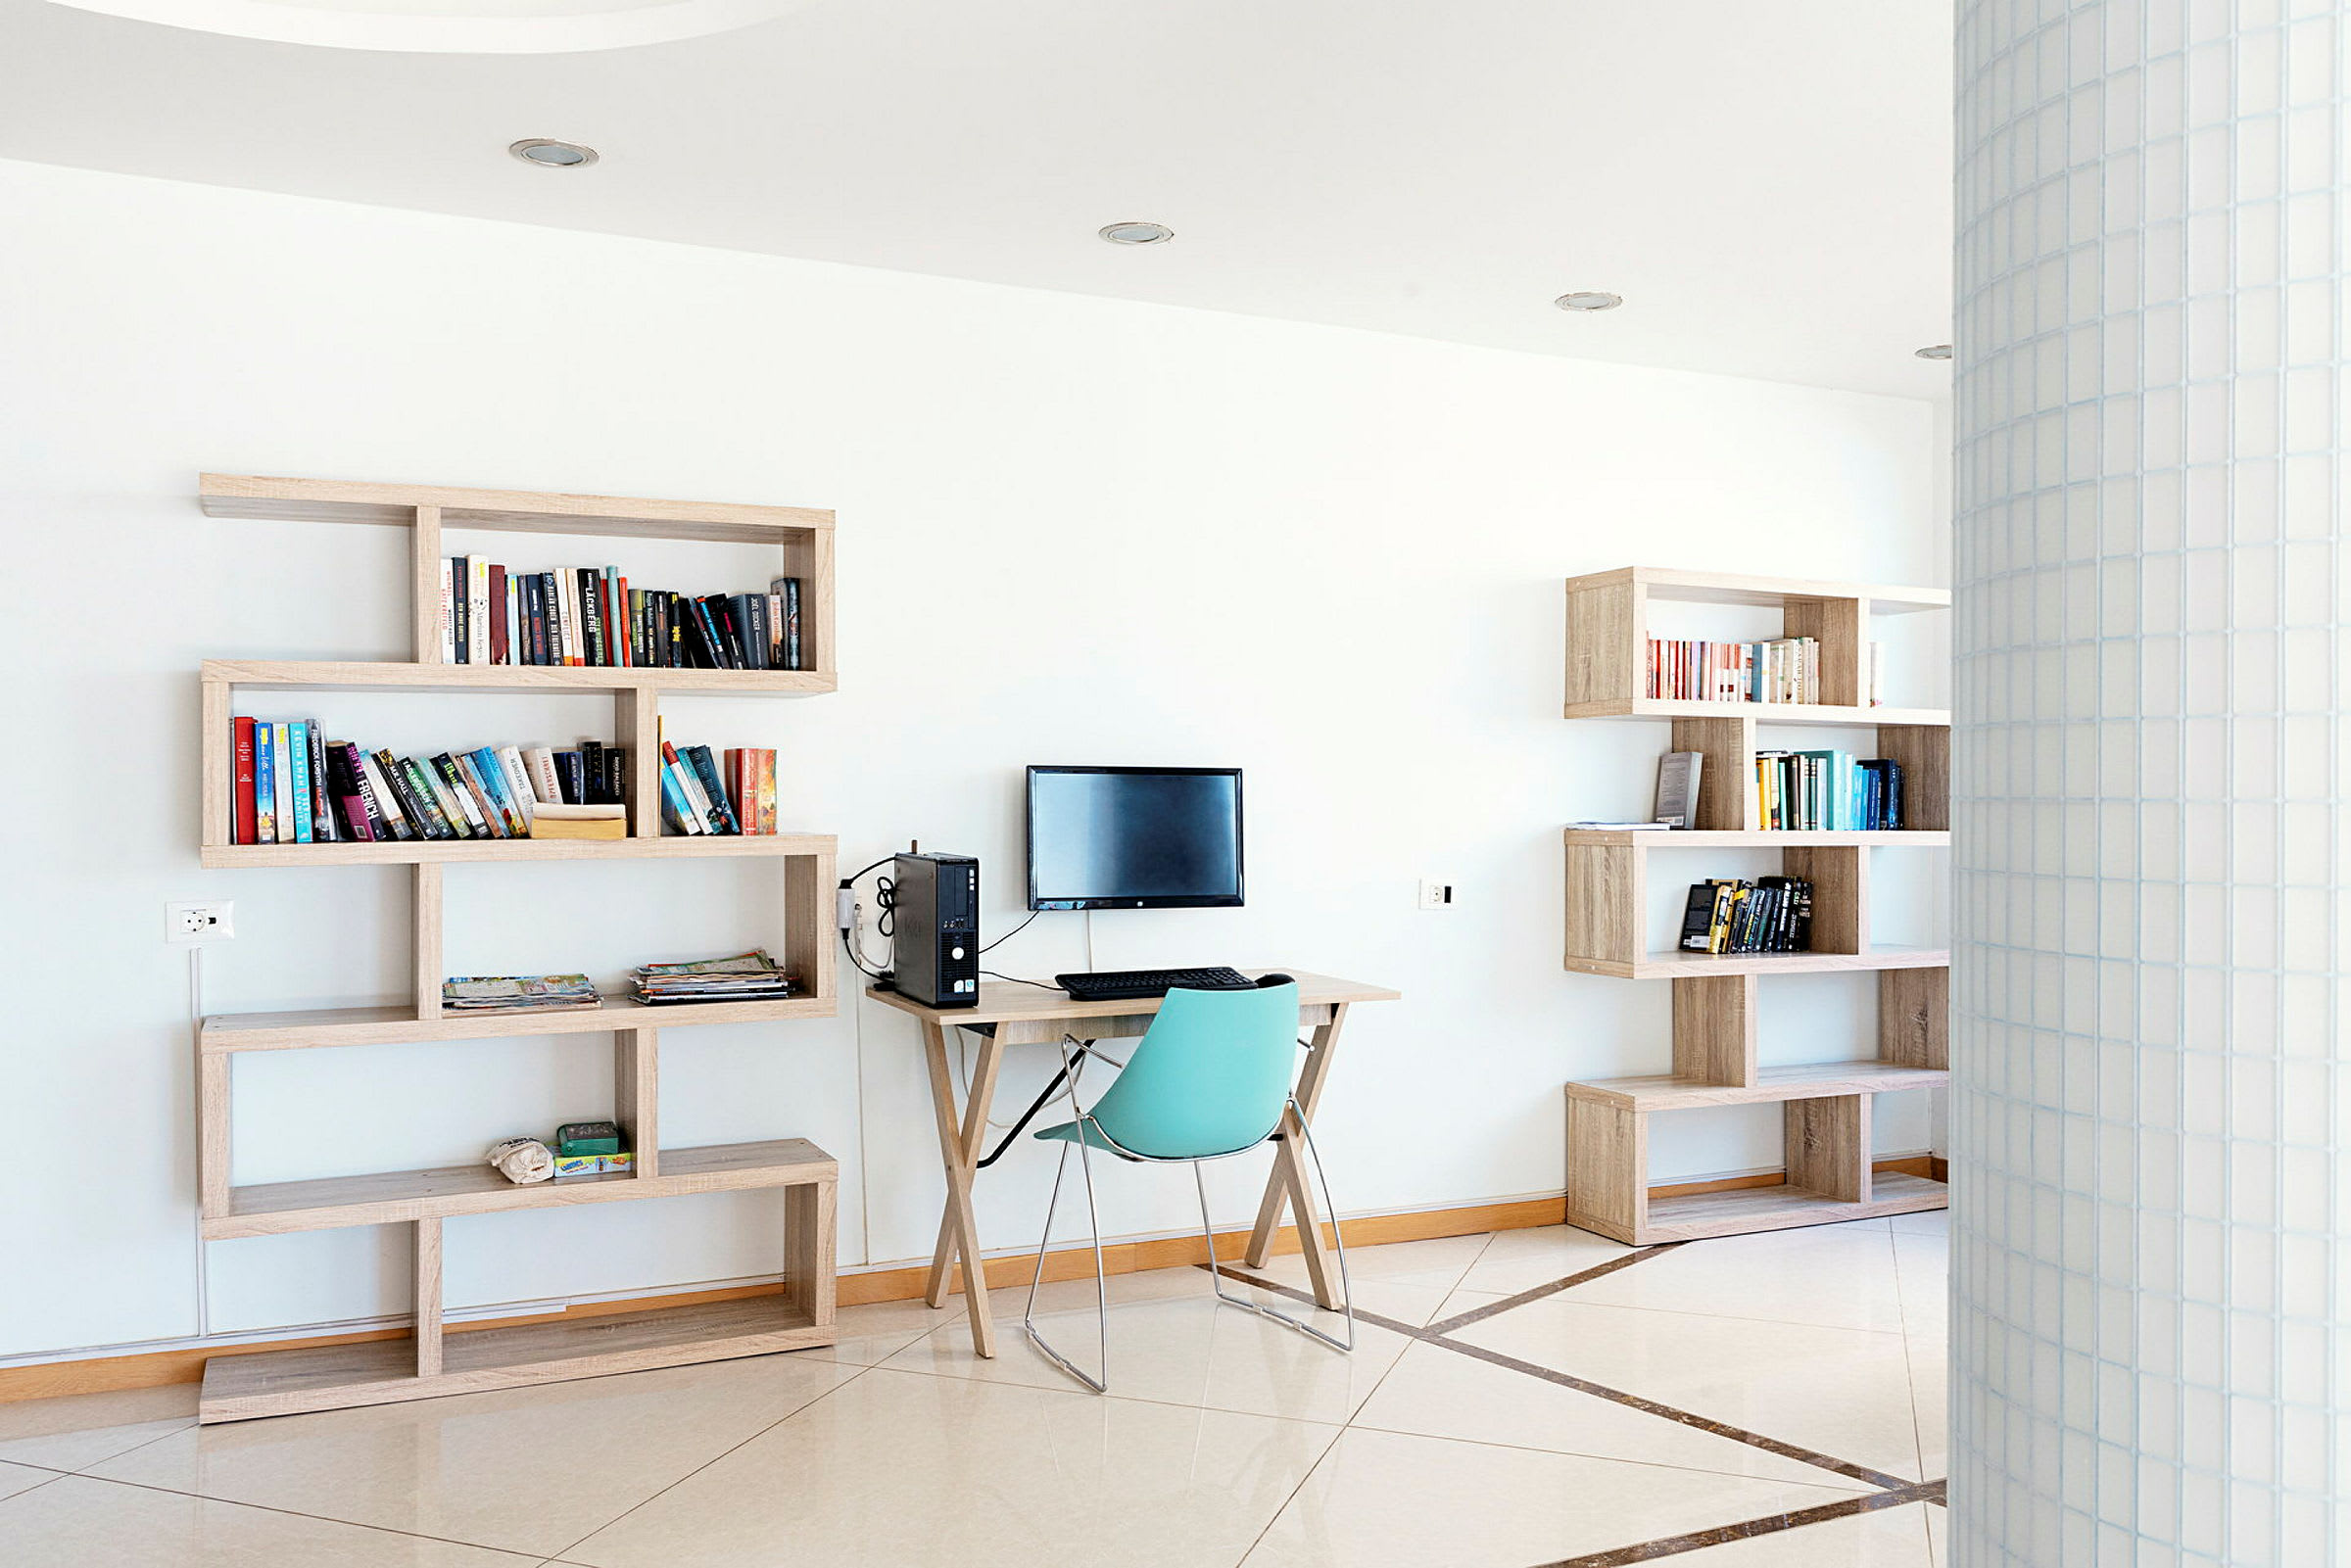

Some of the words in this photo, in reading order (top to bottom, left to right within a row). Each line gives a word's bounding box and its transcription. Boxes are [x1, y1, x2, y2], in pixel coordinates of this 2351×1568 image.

[585, 587, 598, 633] LÄCKBERG
[294, 730, 304, 757] KEVIN
[312, 728, 320, 760] FREDERICK
[297, 760, 306, 786] KWAN
[313, 760, 322, 785] FORSYTH
[509, 758, 526, 790] TAKEOVER
[358, 779, 380, 821] FRENCH
[396, 779, 408, 796] HALL
